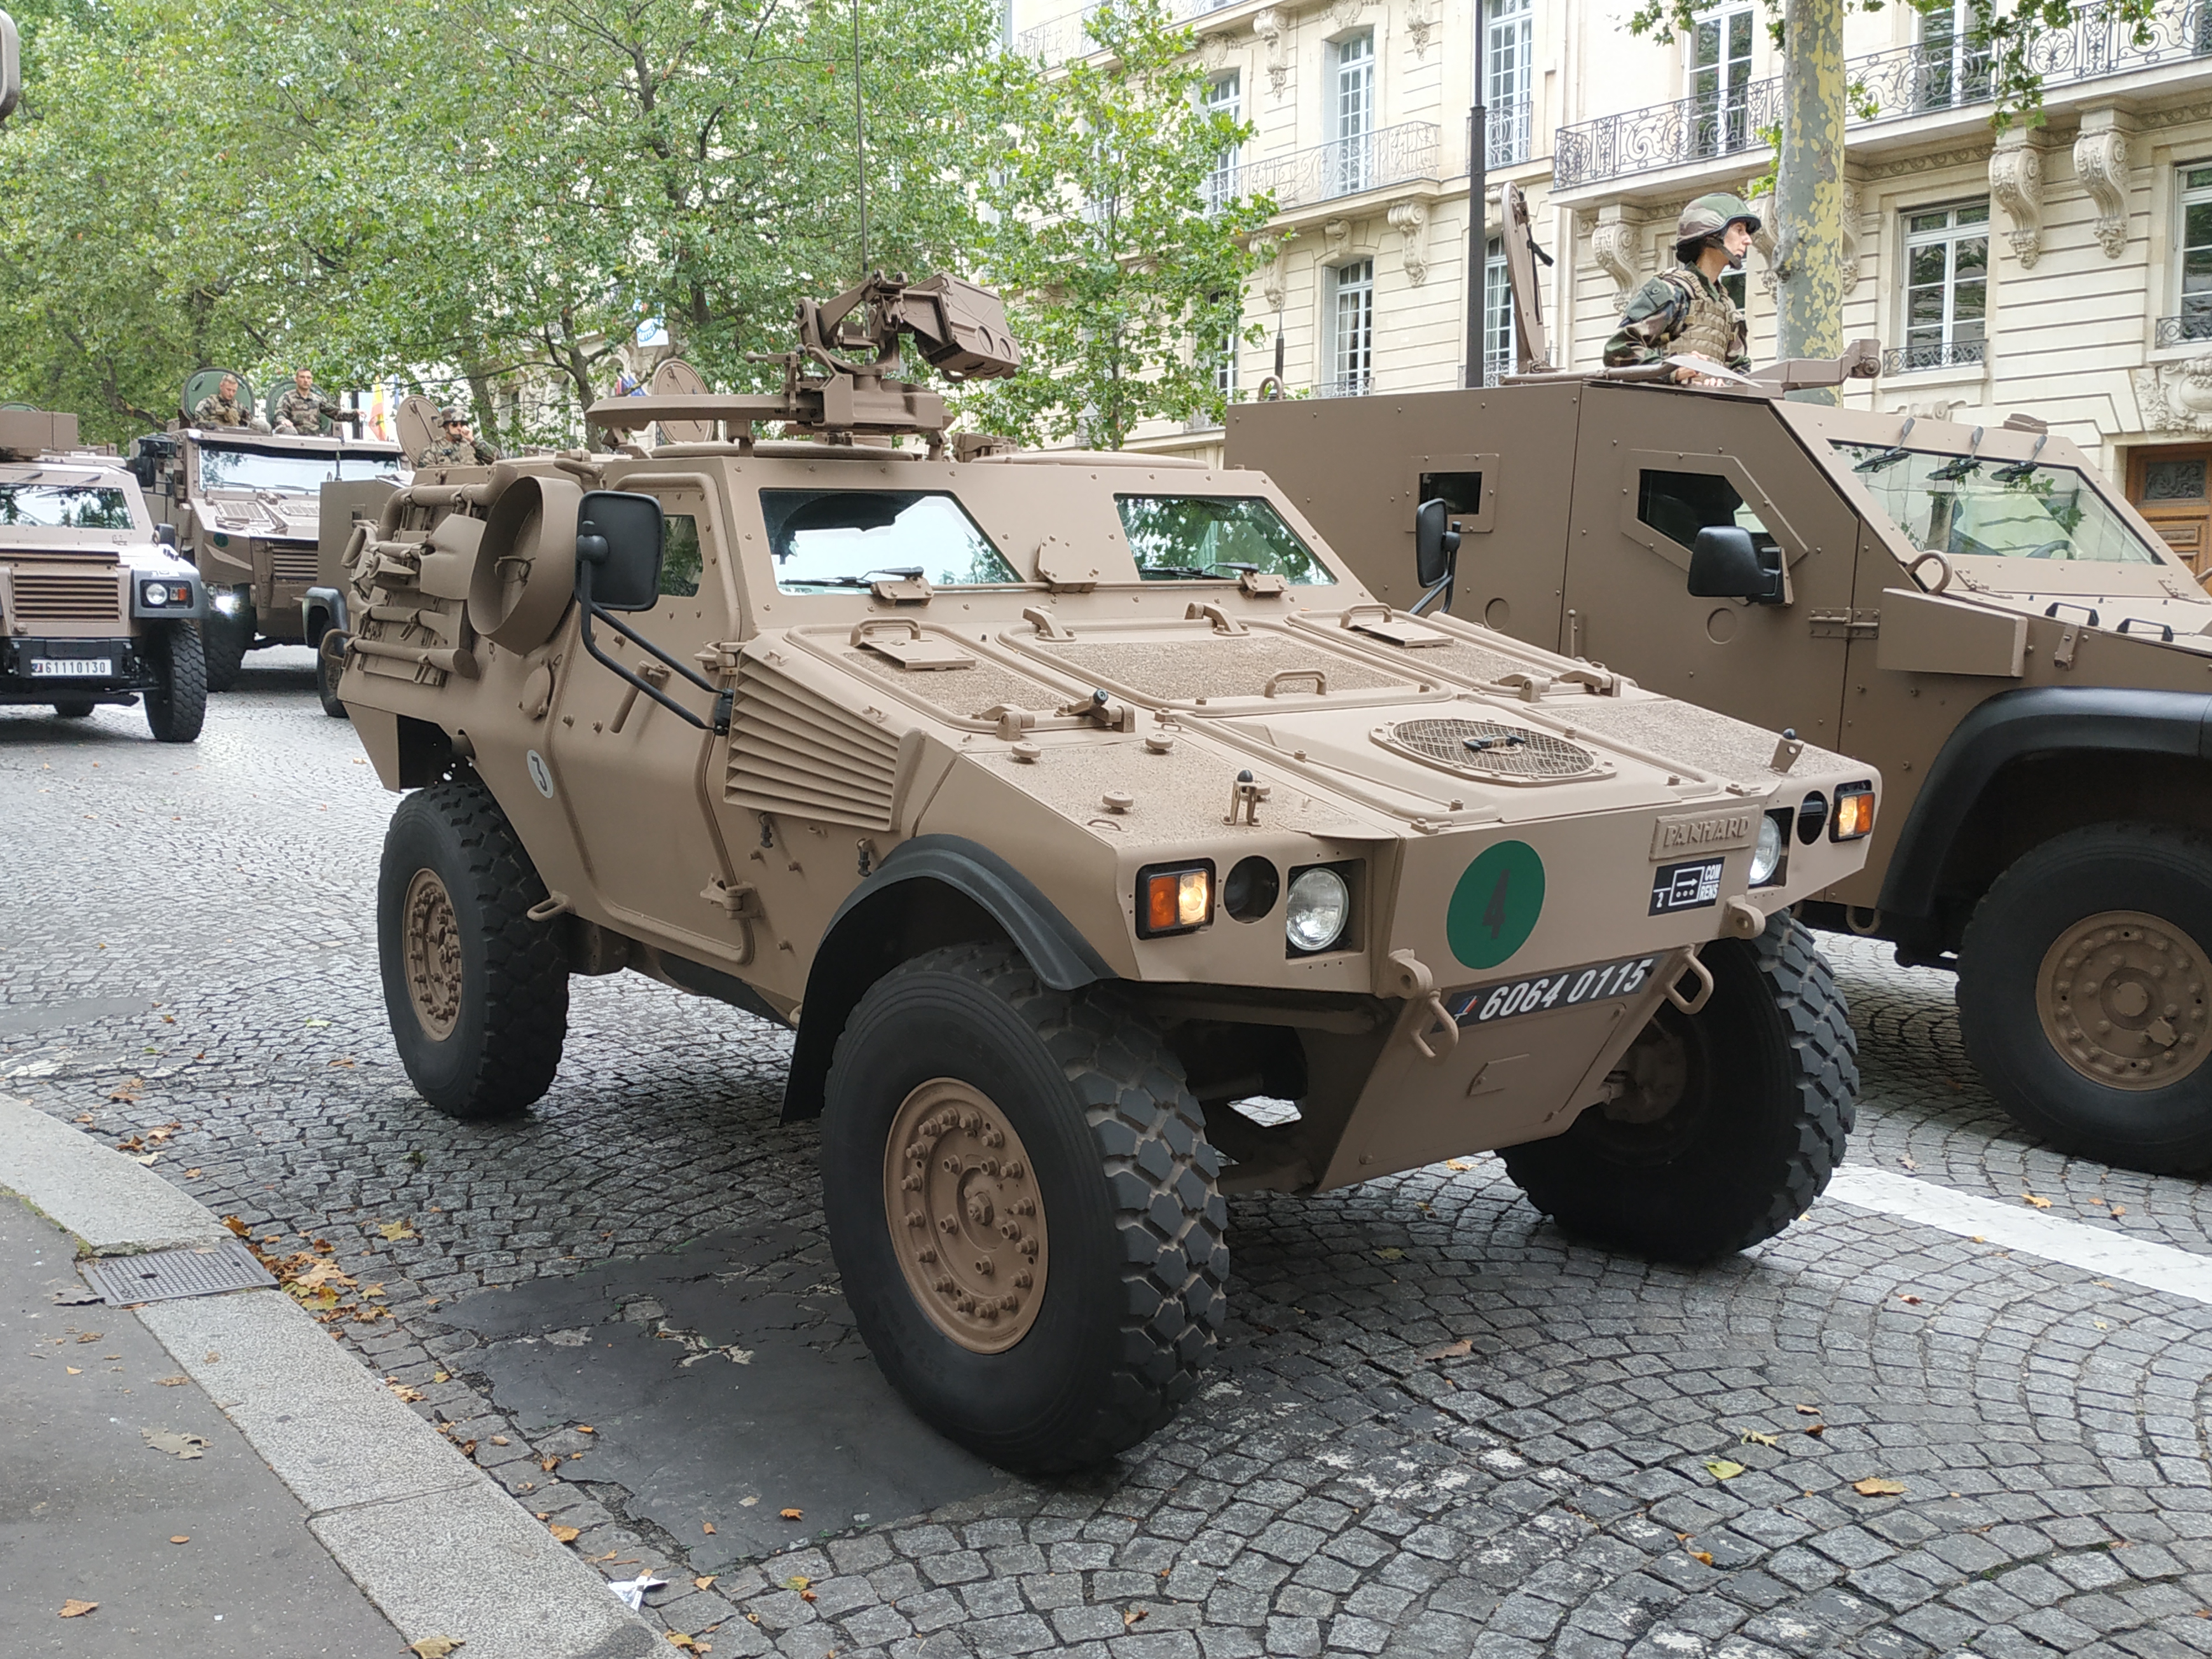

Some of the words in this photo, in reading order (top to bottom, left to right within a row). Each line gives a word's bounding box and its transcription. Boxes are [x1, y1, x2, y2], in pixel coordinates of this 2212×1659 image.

[531, 755, 548, 791] 3
[1663, 816, 1750, 847] PANHARD
[1704, 864, 1722, 880] COM
[1482, 868, 1510, 939] 4
[1656, 891, 1664, 907] 2
[1699, 883, 1719, 901] RENS
[1479, 974, 1569, 1020] 6064
[1566, 958, 1654, 1003] 0115
